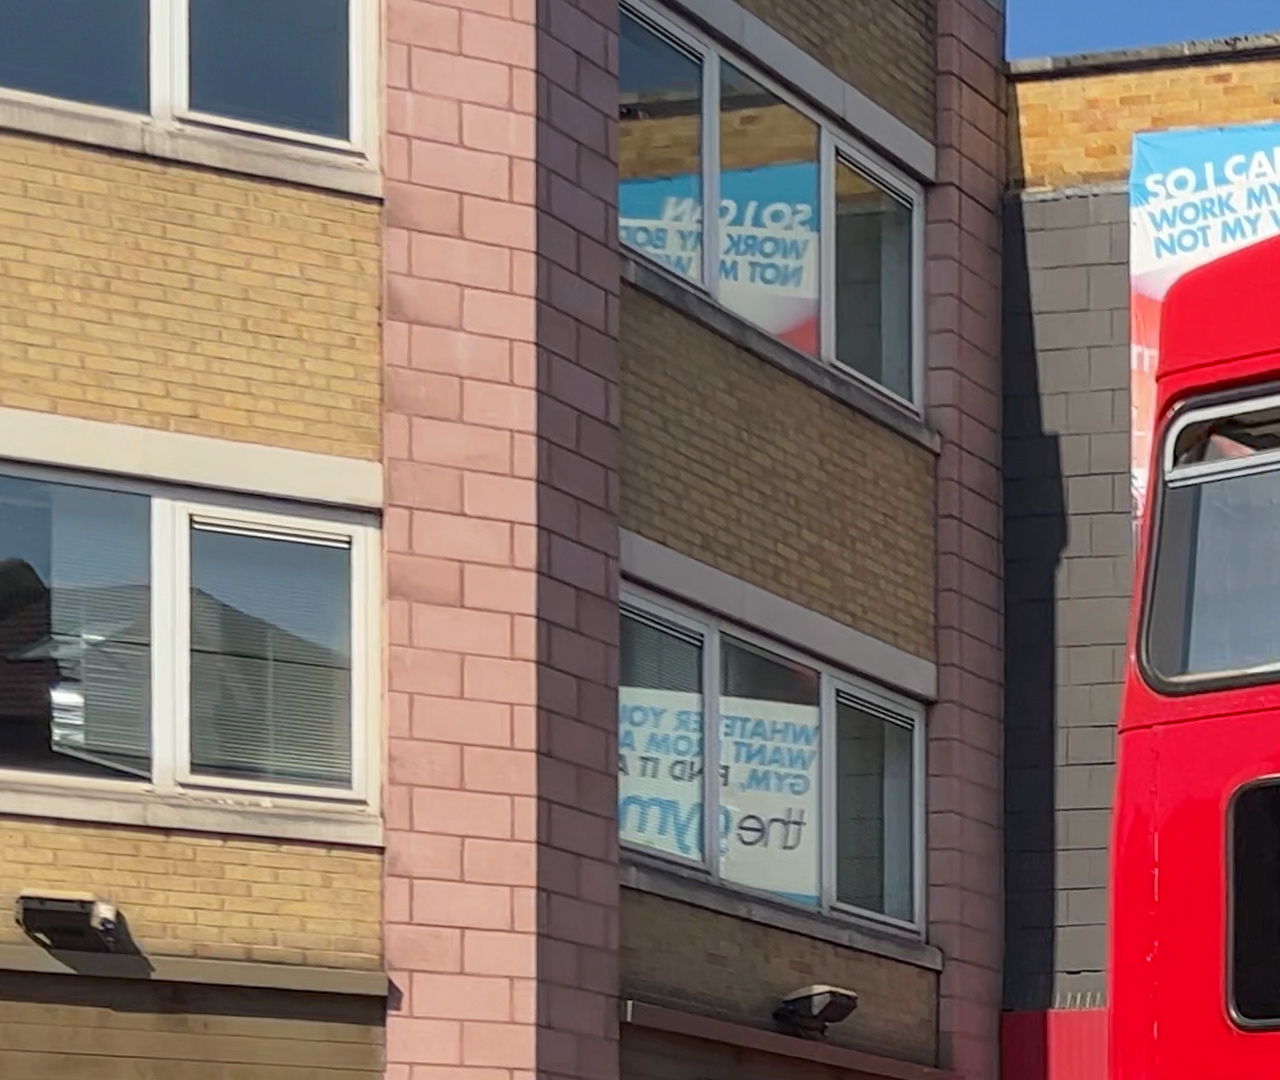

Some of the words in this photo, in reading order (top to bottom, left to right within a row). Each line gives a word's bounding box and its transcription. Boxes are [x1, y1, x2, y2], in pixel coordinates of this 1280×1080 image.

[1145, 167, 1197, 200] SO
[1205, 162, 1216, 190] I
[1148, 192, 1237, 233] WORK
[1153, 224, 1211, 260] NOT
[1221, 212, 1262, 243] MY
